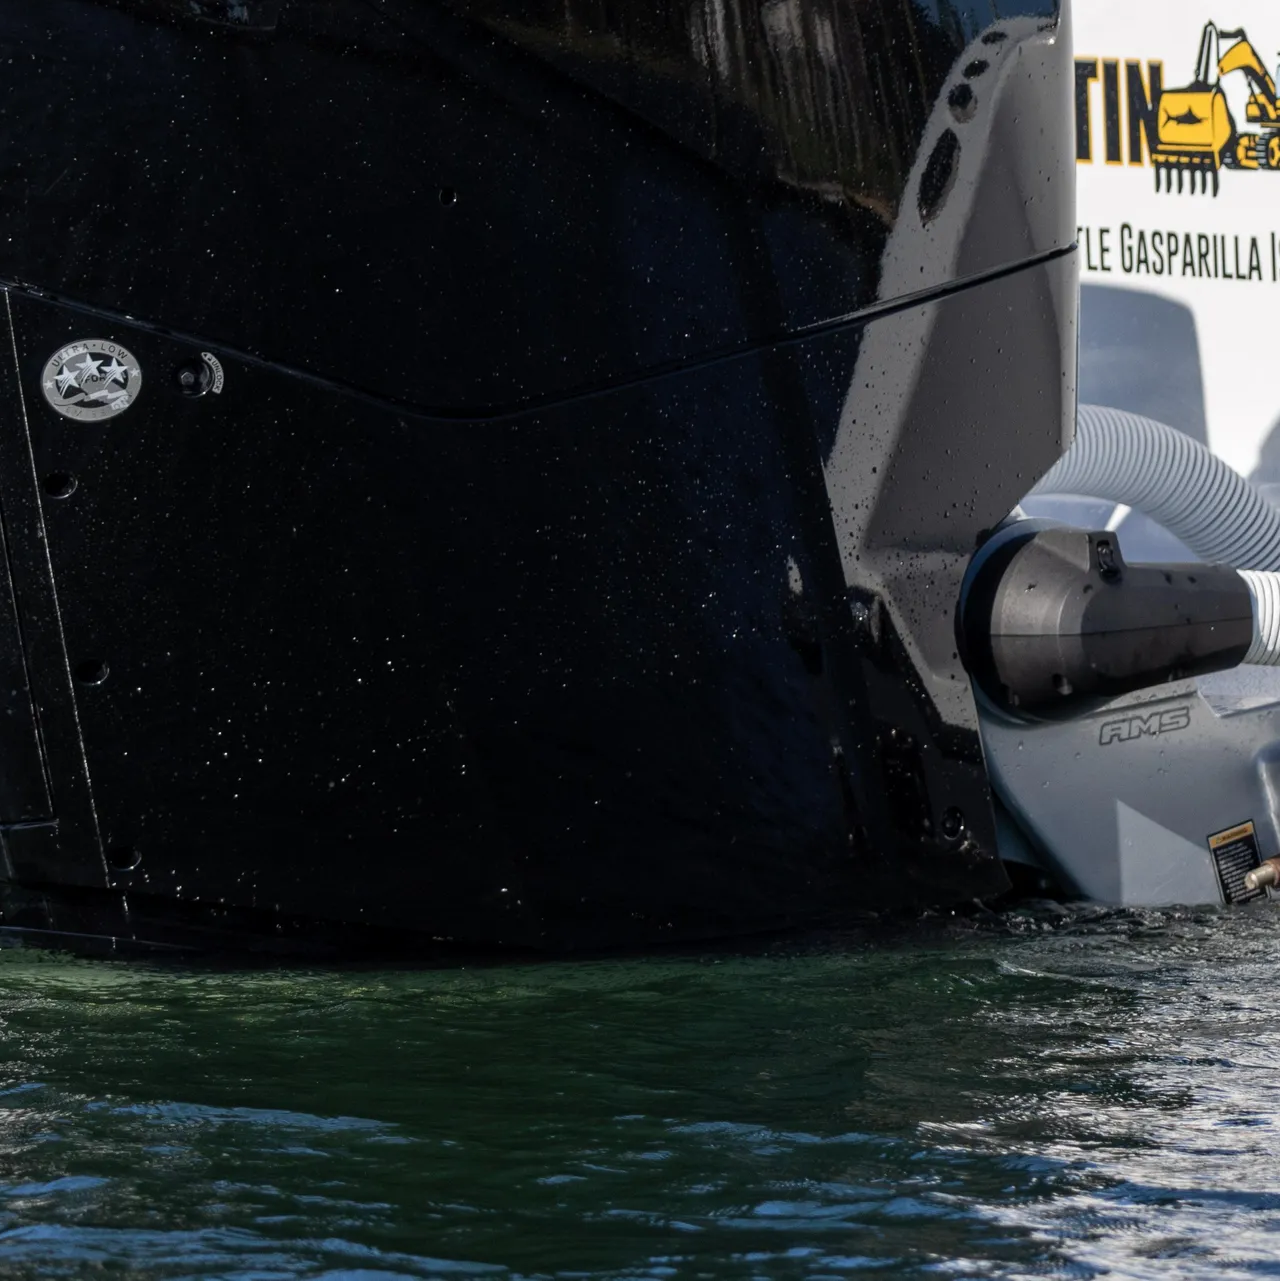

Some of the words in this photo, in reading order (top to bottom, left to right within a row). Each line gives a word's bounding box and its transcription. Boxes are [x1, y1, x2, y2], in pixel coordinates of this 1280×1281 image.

[1120, 222, 1263, 282] GASPARILLA
[51, 342, 90, 368] ULTRA
[100, 342, 128, 360] LOW
[211, 360, 224, 393] UNLOCK
[1099, 705, 1191, 746] AMS
